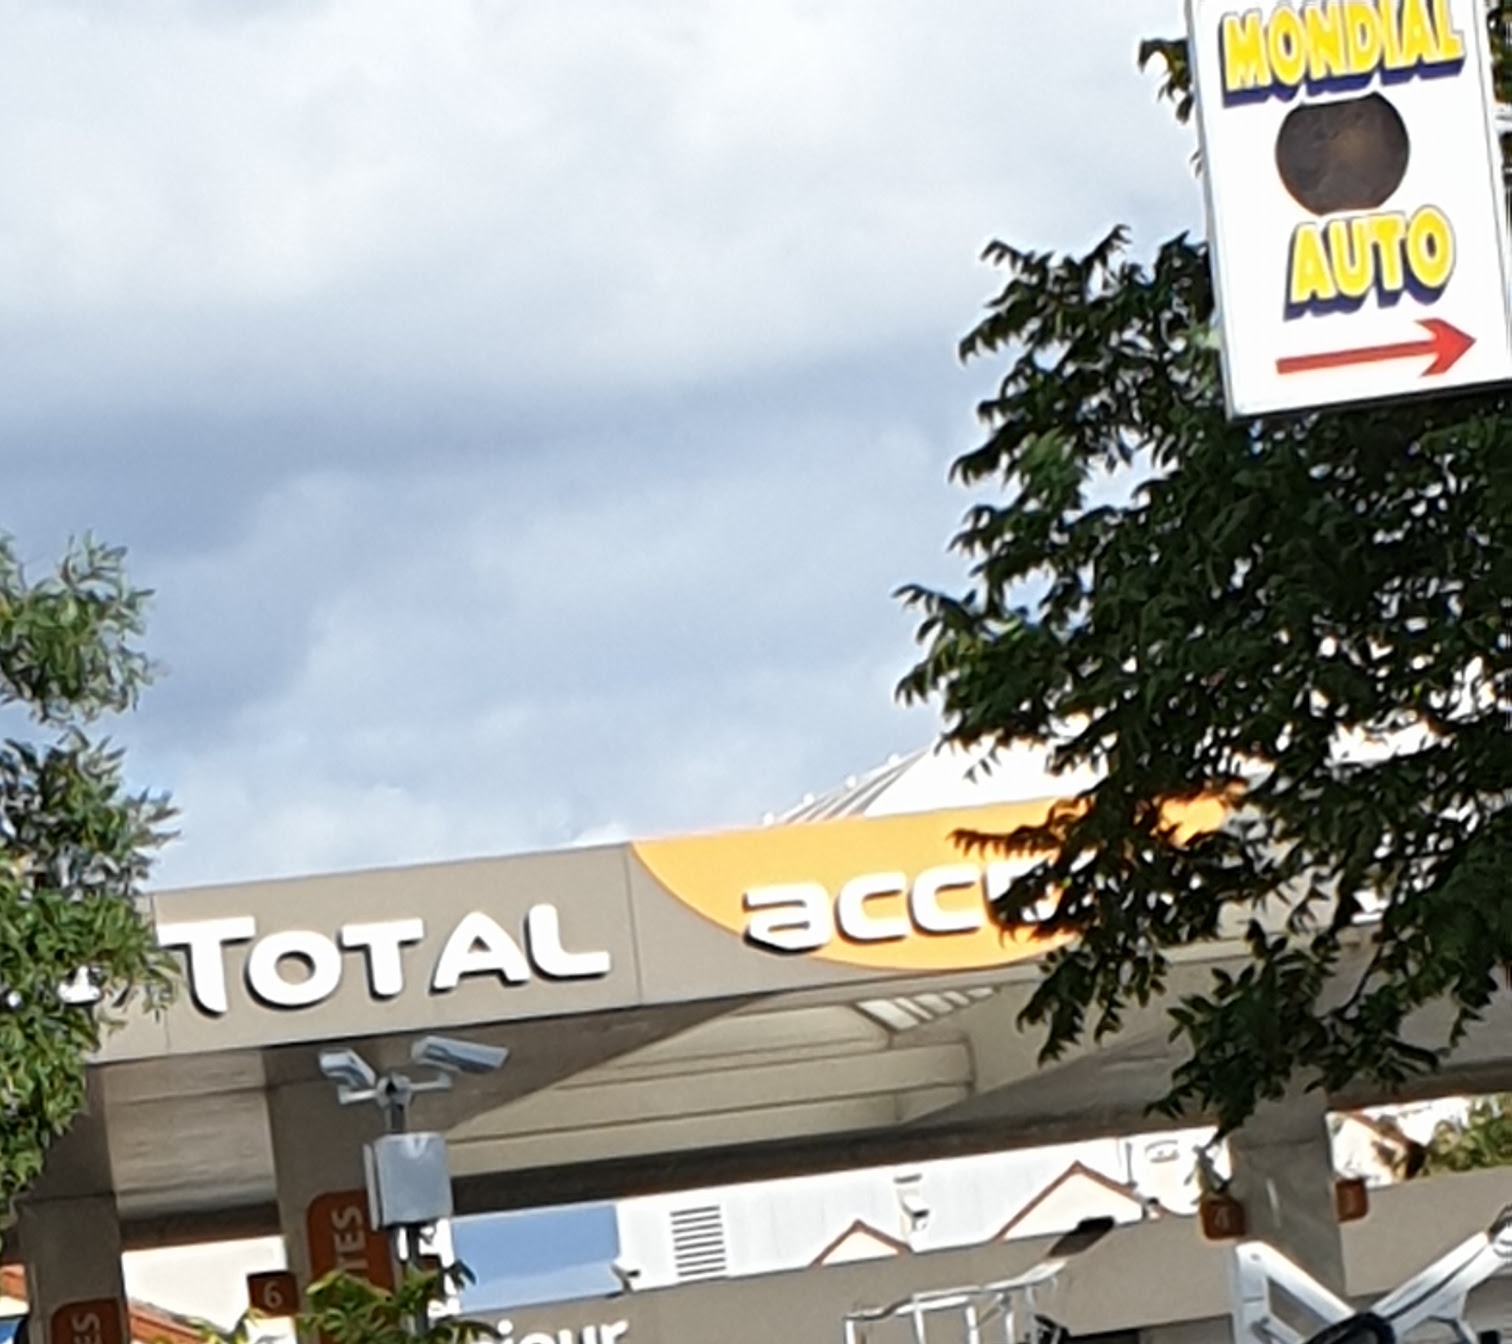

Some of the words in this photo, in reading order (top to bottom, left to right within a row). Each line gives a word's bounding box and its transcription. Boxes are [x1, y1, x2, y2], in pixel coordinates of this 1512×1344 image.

[1220, 0, 1465, 106] MONDIAL
[1284, 204, 1456, 321] AUTO
[157, 903, 611, 1018] TOTAL
[331, 1205, 370, 1270] TES
[263, 1280, 283, 1308] 6
